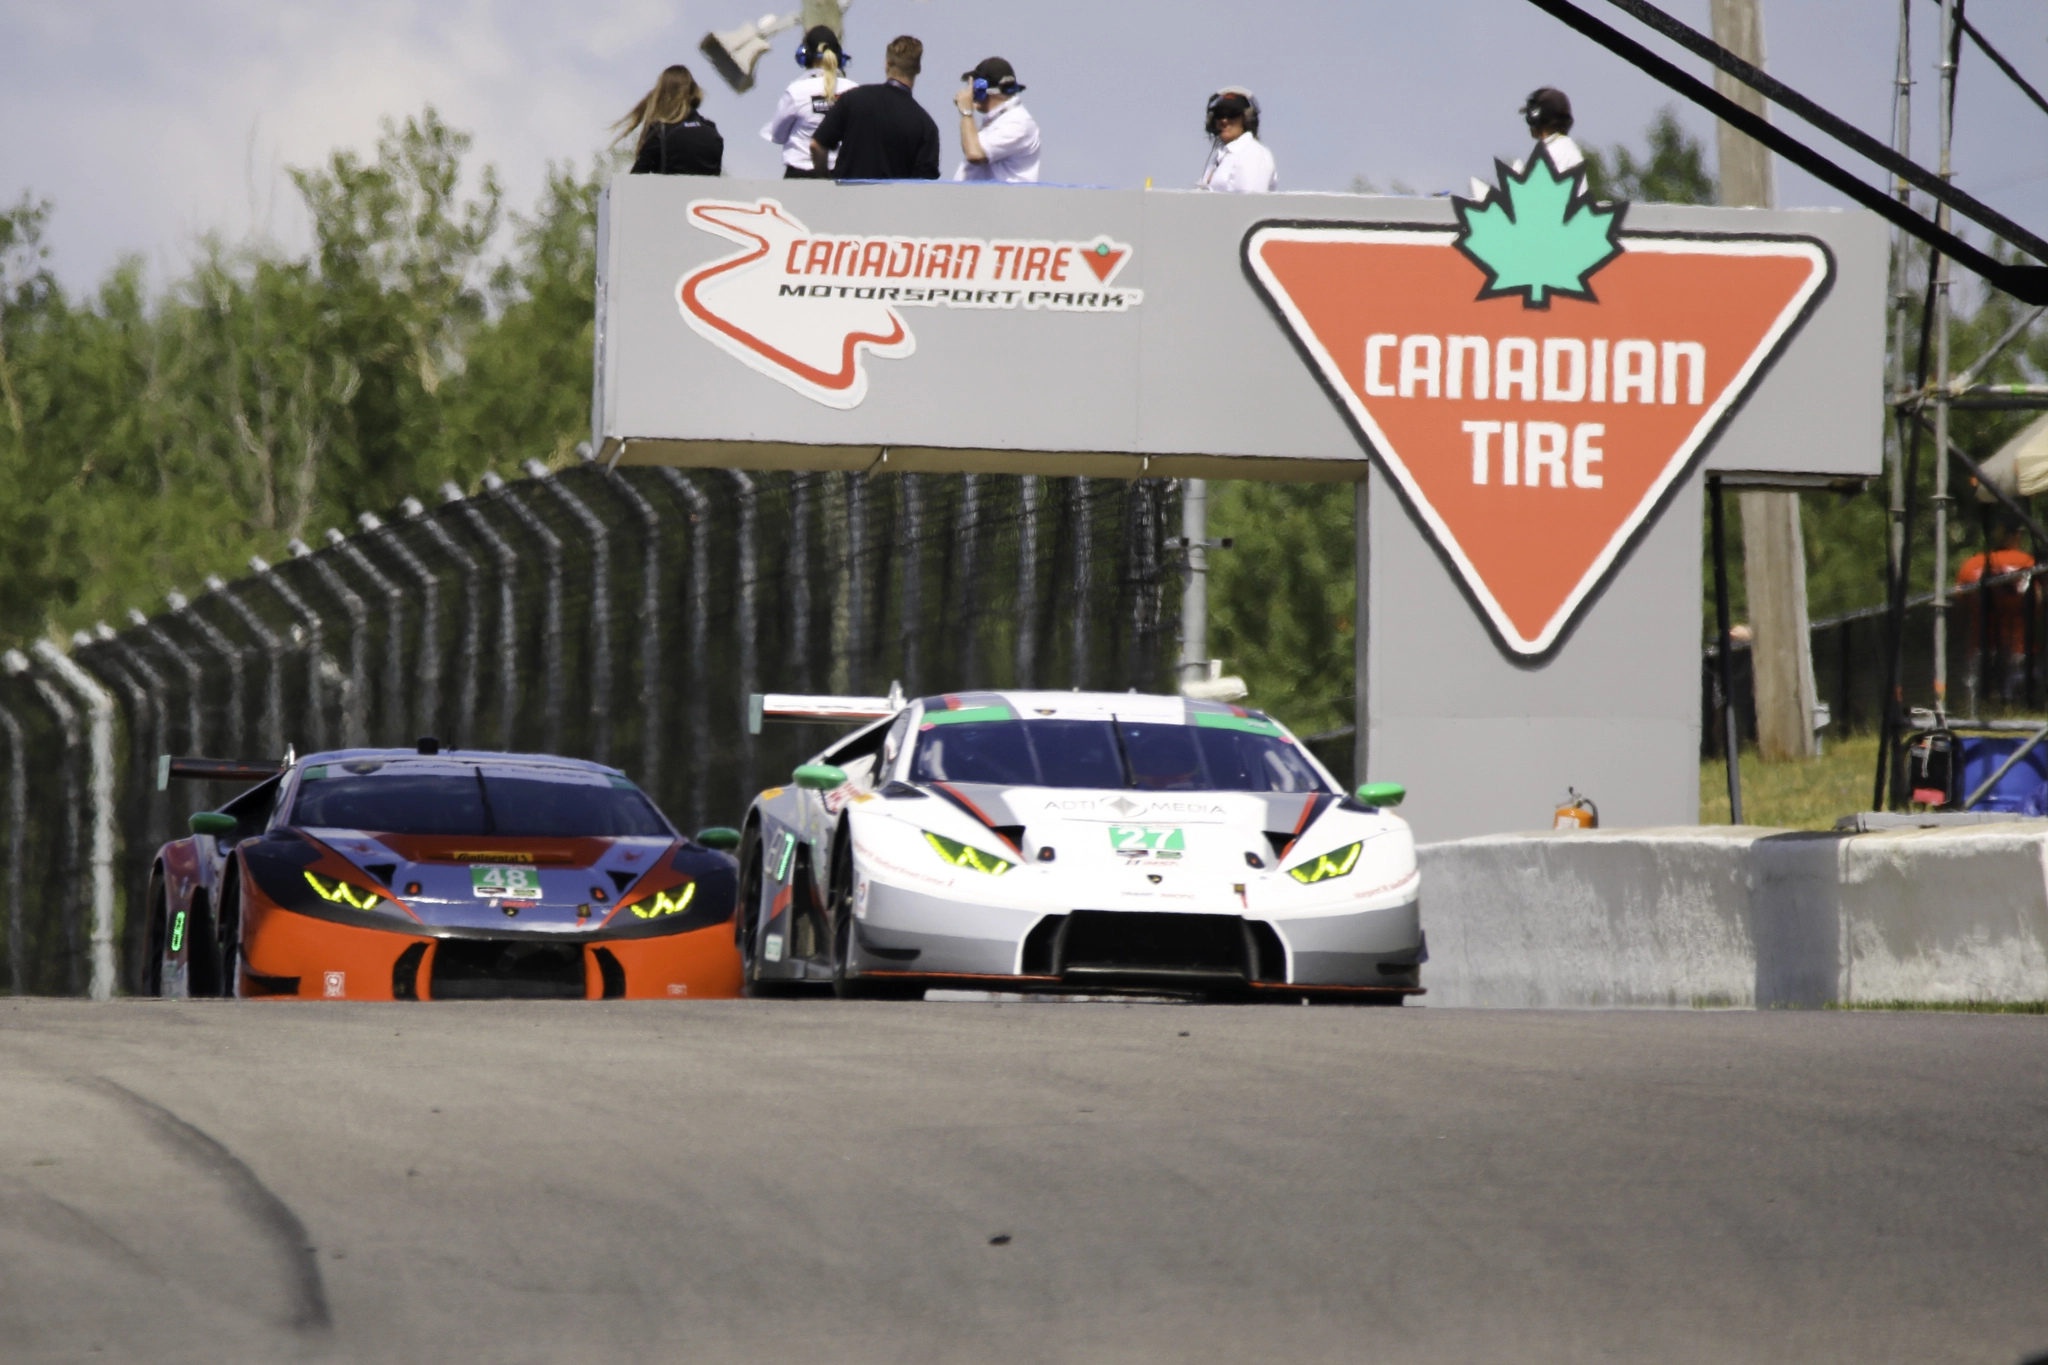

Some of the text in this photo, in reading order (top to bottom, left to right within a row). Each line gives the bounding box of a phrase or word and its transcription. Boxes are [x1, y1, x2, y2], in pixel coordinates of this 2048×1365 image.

[785, 239, 1073, 283] CANADIAN TIRE
[778, 283, 1023, 305] MOTORSPORT
[1027, 290, 1126, 308] PARK
[1363, 333, 1706, 405] CANADIAN
[1461, 420, 1606, 489] TIRE
[1150, 801, 1227, 815] MEDIA
[1117, 826, 1176, 849] 27
[458, 853, 519, 862] Continental
[483, 868, 529, 889] 48
